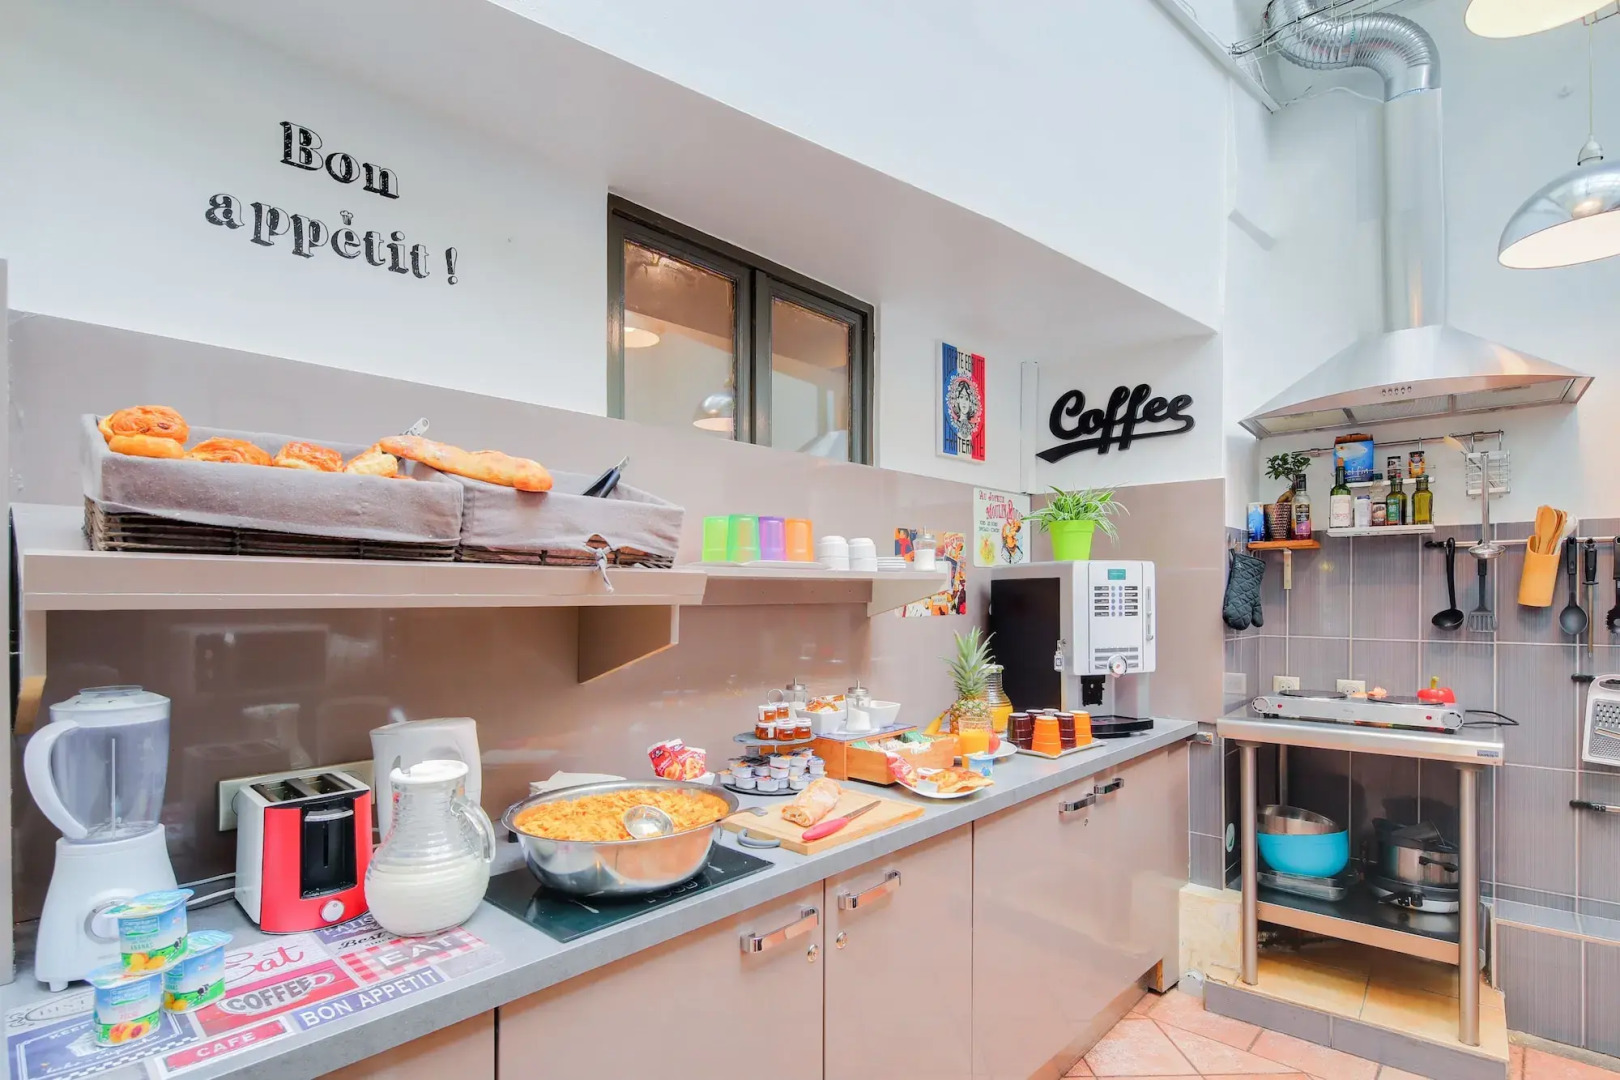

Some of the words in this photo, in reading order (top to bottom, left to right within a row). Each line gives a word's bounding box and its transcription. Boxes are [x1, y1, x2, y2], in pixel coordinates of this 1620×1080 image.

[279, 121, 400, 200] Bon
[445, 247, 458, 285] !
[1036, 384, 1196, 464] Coffee
[378, 935, 453, 967] EAT
[227, 975, 312, 1012] COFFEE
[301, 1002, 354, 1027] BON
[357, 969, 440, 1010] APPETIT
[196, 1032, 256, 1057] CAFE
